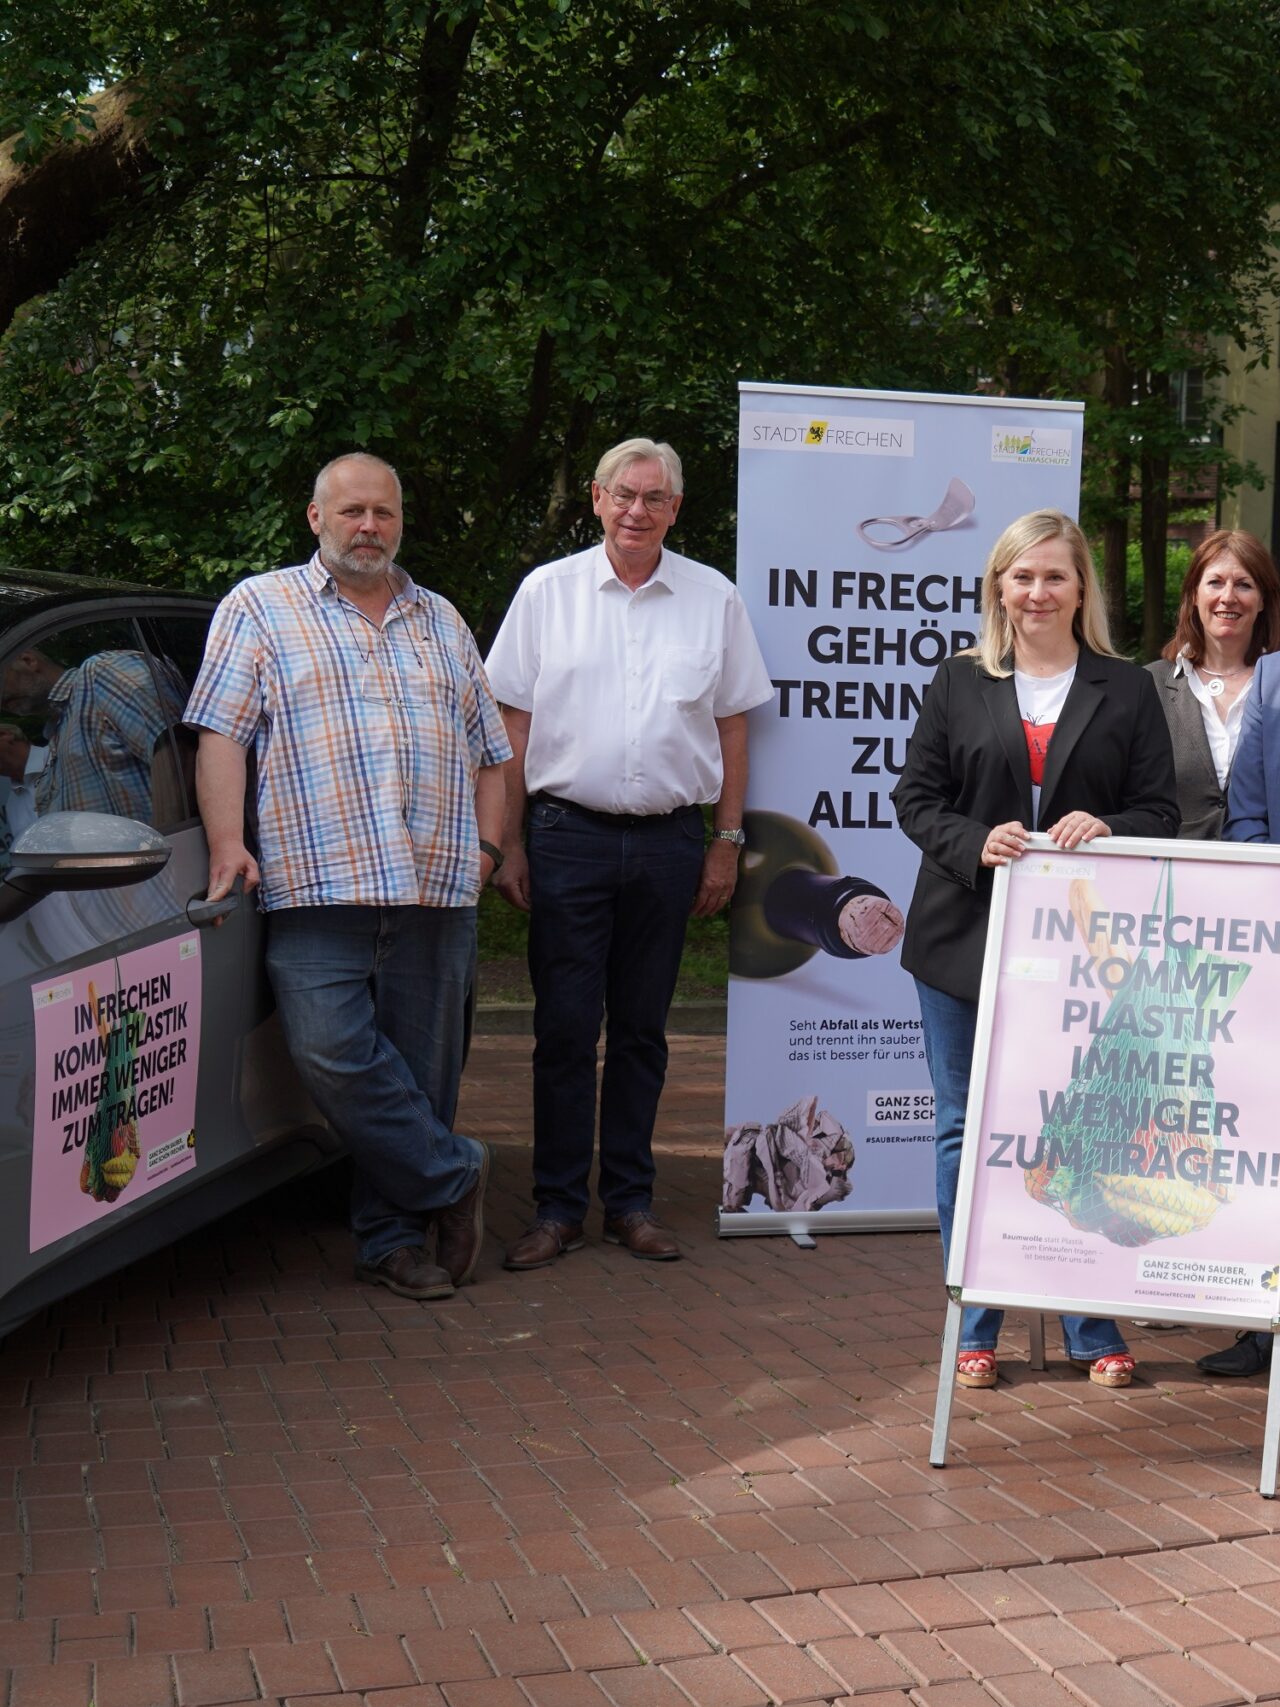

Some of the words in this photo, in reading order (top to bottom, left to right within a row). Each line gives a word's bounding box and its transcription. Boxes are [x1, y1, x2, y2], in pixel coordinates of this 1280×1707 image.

[753, 426, 806, 442] STADT
[826, 430, 903, 448] FRECHEN
[768, 568, 818, 608] IN
[832, 570, 983, 614] FRECH
[770, 680, 932, 720] TRENN
[852, 736, 912, 776] ZU
[808, 791, 896, 829] ALL
[1031, 907, 1075, 942] IN
[1069, 954, 1240, 998] KOMMT
[74, 1002, 92, 1034] IN
[97, 972, 171, 1026] FRECHEN
[1061, 998, 1237, 1044] PLASTIK
[54, 1027, 122, 1082] KOMMT
[126, 1002, 188, 1051] PLASTIK
[789, 1035, 812, 1046] und
[816, 1036, 854, 1046] trennt
[857, 1034, 876, 1045] ihn
[880, 1034, 920, 1045] sauber
[790, 1020, 816, 1031] Seht
[820, 1019, 858, 1030] Abfall
[861, 1019, 879, 1030] als
[883, 1019, 924, 1030] Wertst
[788, 1050, 810, 1061] das
[813, 1050, 827, 1060] ist
[830, 1050, 870, 1060] besser
[873, 1049, 891, 1060] für
[894, 1050, 915, 1060] uns
[1070, 1045, 1215, 1090] IMMER
[52, 1070, 110, 1122] IMMER
[114, 1037, 187, 1092] WENIGER
[62, 1109, 101, 1154] ZUM
[108, 1077, 175, 1130] TRAGEN!
[874, 1110, 910, 1121] GANZ
[913, 1110, 936, 1120] SCH
[875, 1096, 910, 1107] GANZ
[914, 1096, 936, 1106] SCH
[1038, 1089, 1240, 1138] WENIGER
[866, 1136, 936, 1144] #SAUBERwieFRECH
[986, 1132, 1083, 1171] ZUM
[1002, 1233, 1042, 1242] Baumwolle
[1038, 1245, 1072, 1254] Einkaufen
[1142, 1270, 1169, 1280] GANZ
[1171, 1272, 1205, 1283] SCHÖN
[1207, 1276, 1254, 1286] FRECHEN!
[1144, 1260, 1170, 1270] GANZ
[1172, 1262, 1206, 1273] SCHÖN
[1208, 1266, 1247, 1276] SAUBER,
